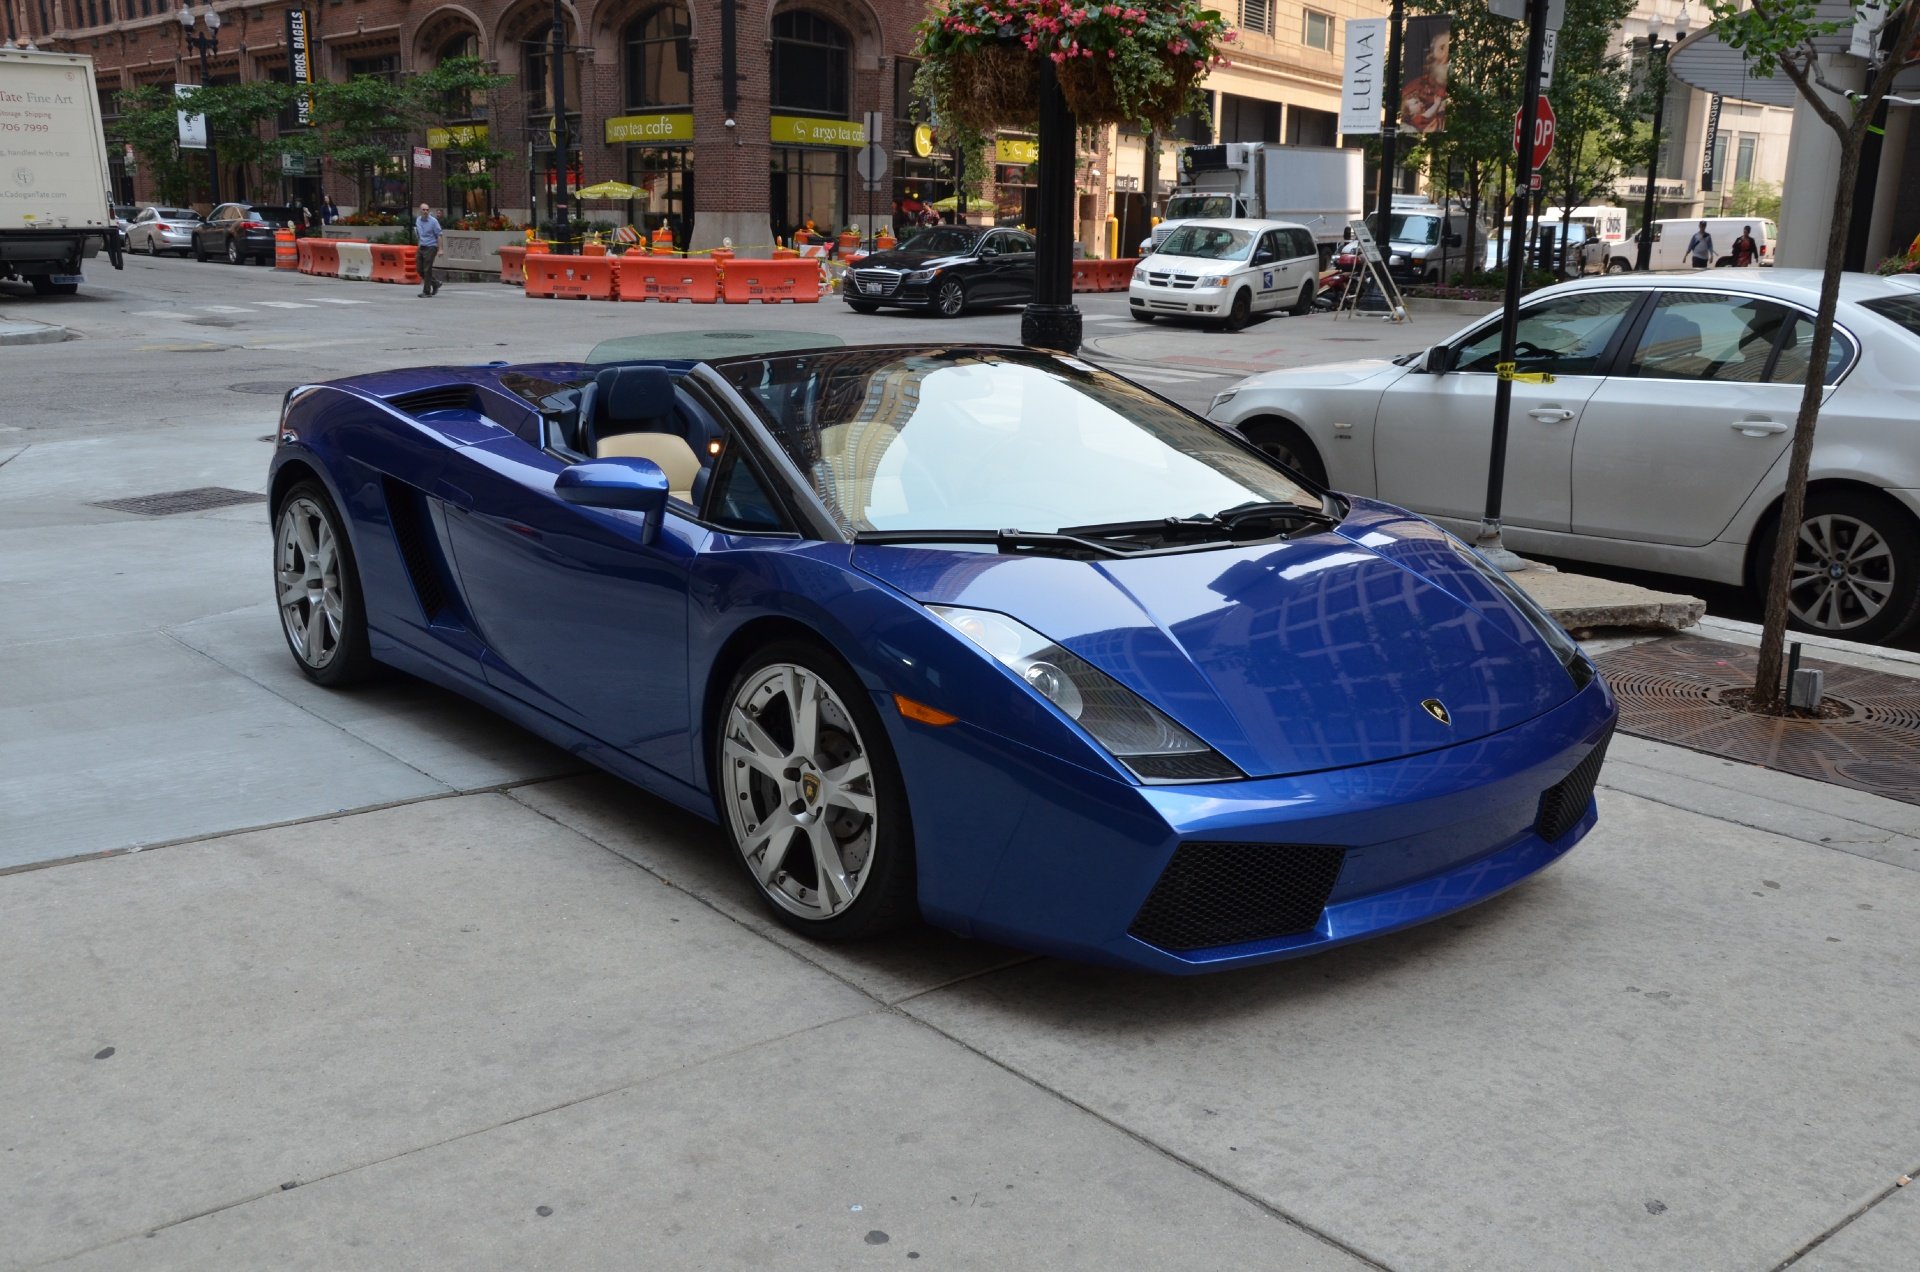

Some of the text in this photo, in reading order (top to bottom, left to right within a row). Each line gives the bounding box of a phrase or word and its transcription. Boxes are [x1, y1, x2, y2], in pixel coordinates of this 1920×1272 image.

[291, 11, 305, 49] BAGELS
[1544, 34, 1554, 48] NE
[295, 52, 307, 78] BROS.
[1542, 51, 1553, 65] AY
[1352, 33, 1375, 111] LUMA
[0, 91, 73, 104] Tate Fine Art
[0, 123, 49, 133] 706 7999
[629, 122, 642, 135] tea
[645, 116, 673, 135] café
[812, 127, 836, 143] argo
[838, 126, 850, 140] tea
[1516, 118, 1553, 147] OP
[1703, 150, 1714, 175] rack
